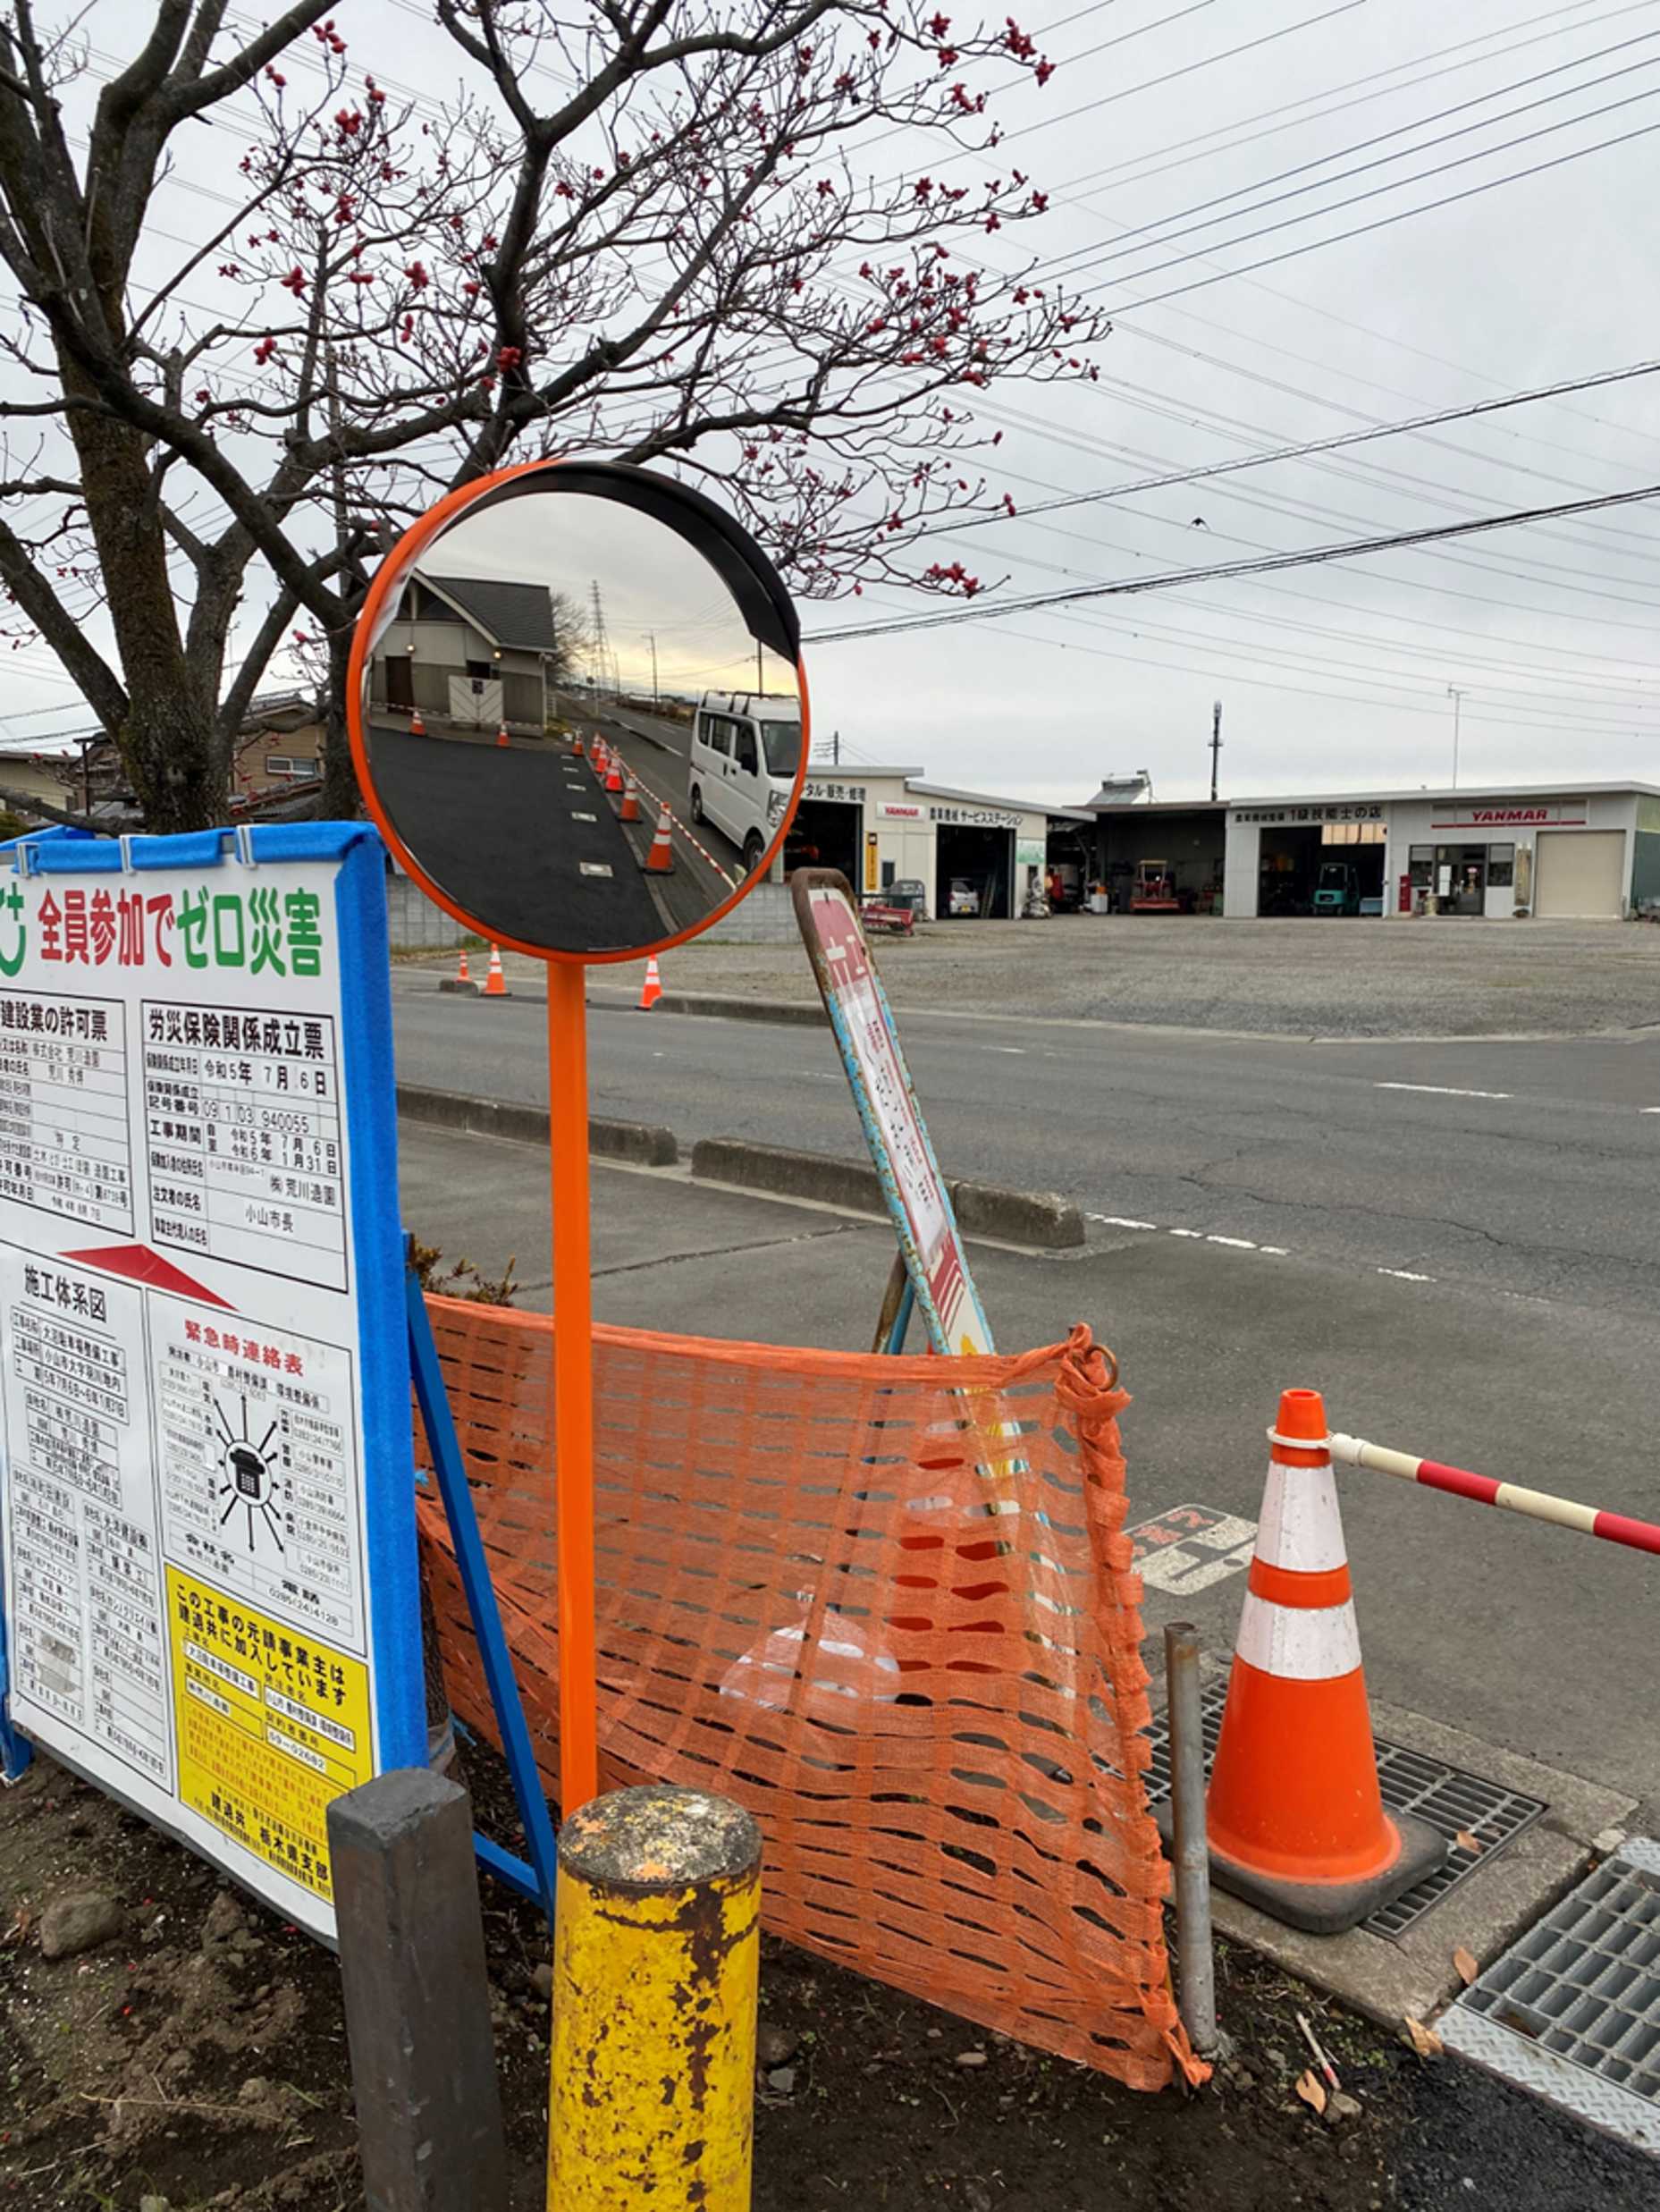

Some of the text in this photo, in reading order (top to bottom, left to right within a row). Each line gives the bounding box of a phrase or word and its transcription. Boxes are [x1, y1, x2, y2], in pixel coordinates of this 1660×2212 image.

[1472, 808, 1548, 822] YANMAR
[38, 885, 323, 977] 全員参加でゼロ災害
[0, 1000, 107, 1042] 建設業の許可票
[148, 1008, 324, 1060] 労災保険関係成立票
[245, 1203, 294, 1233] 小山市長
[23, 1262, 107, 1325] 施工体系図
[183, 1318, 304, 1379] 緊急時連絡表
[175, 1582, 345, 1688] この工事の元請事業主は
[178, 1602, 348, 1711] 建退共に加入しています
